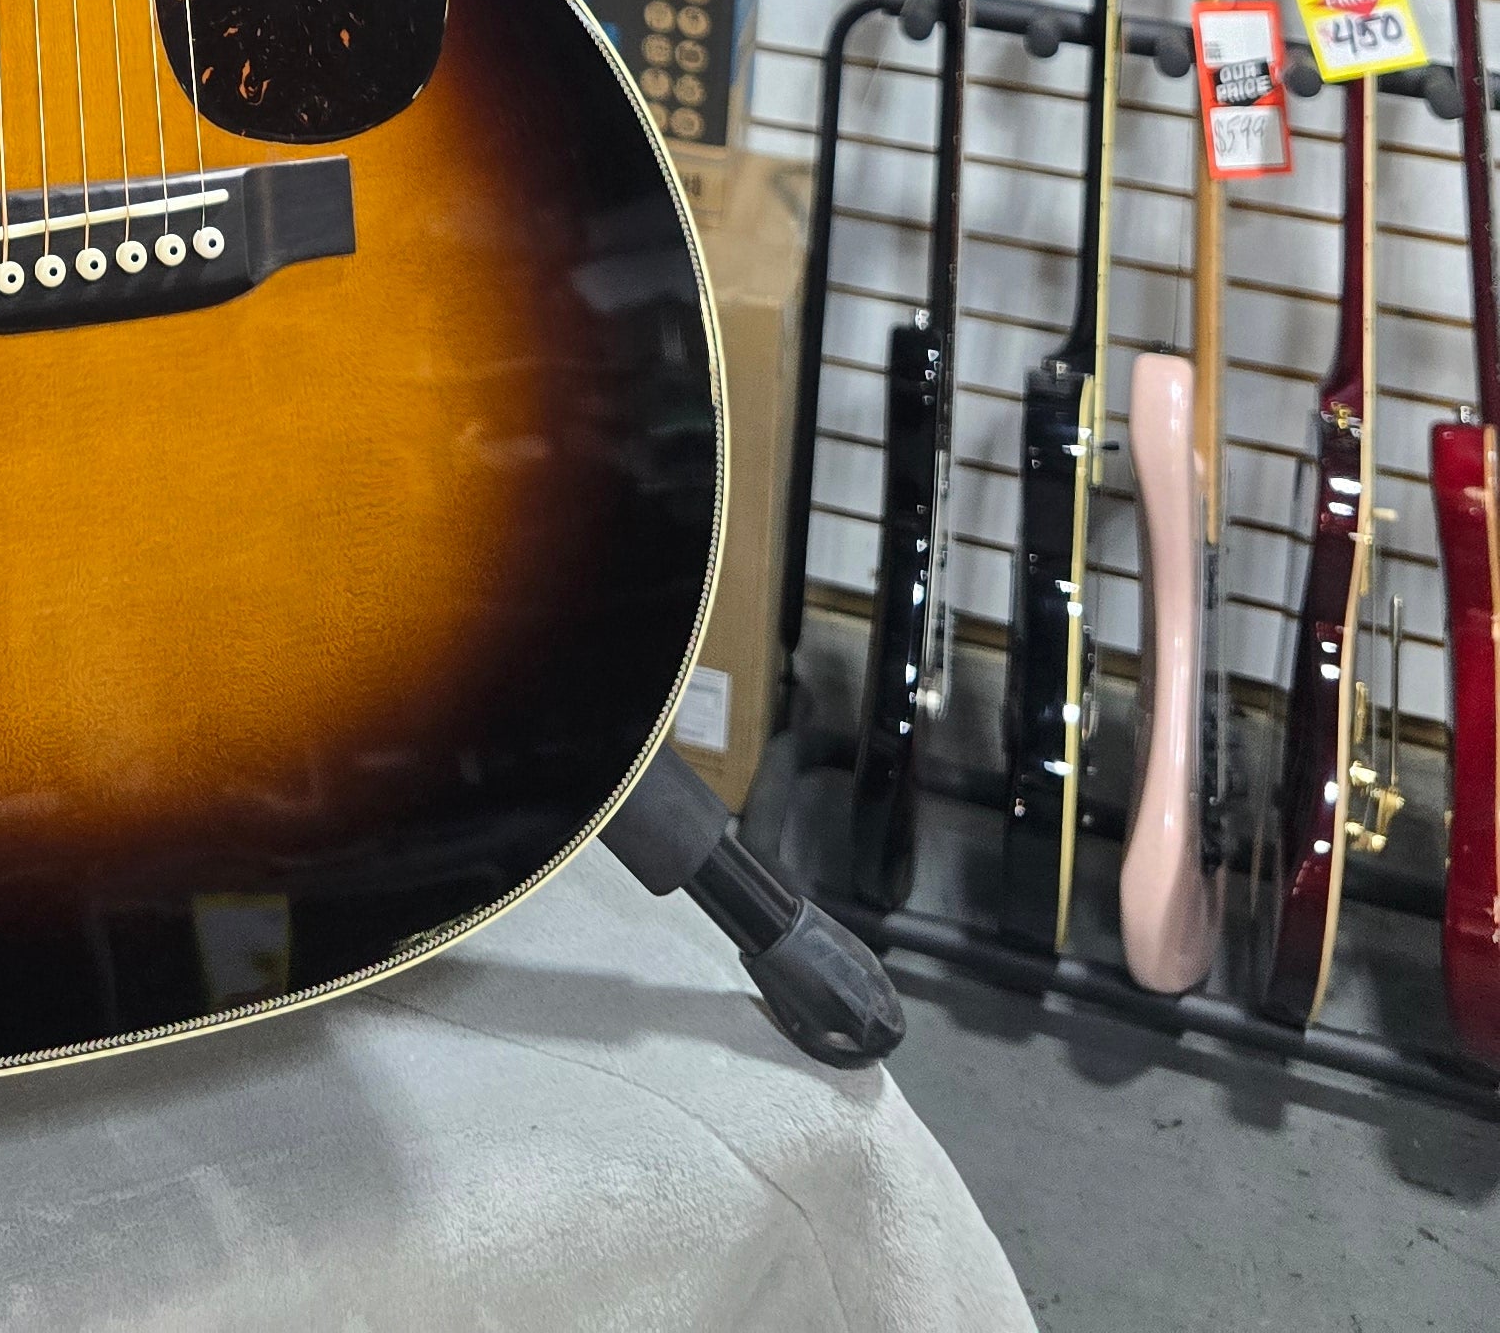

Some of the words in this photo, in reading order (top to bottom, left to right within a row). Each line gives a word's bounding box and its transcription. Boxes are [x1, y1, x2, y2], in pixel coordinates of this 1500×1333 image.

[1219, 62, 1259, 84] OUR
[1215, 74, 1274, 104] PRICE
[1214, 114, 1266, 159] $599
